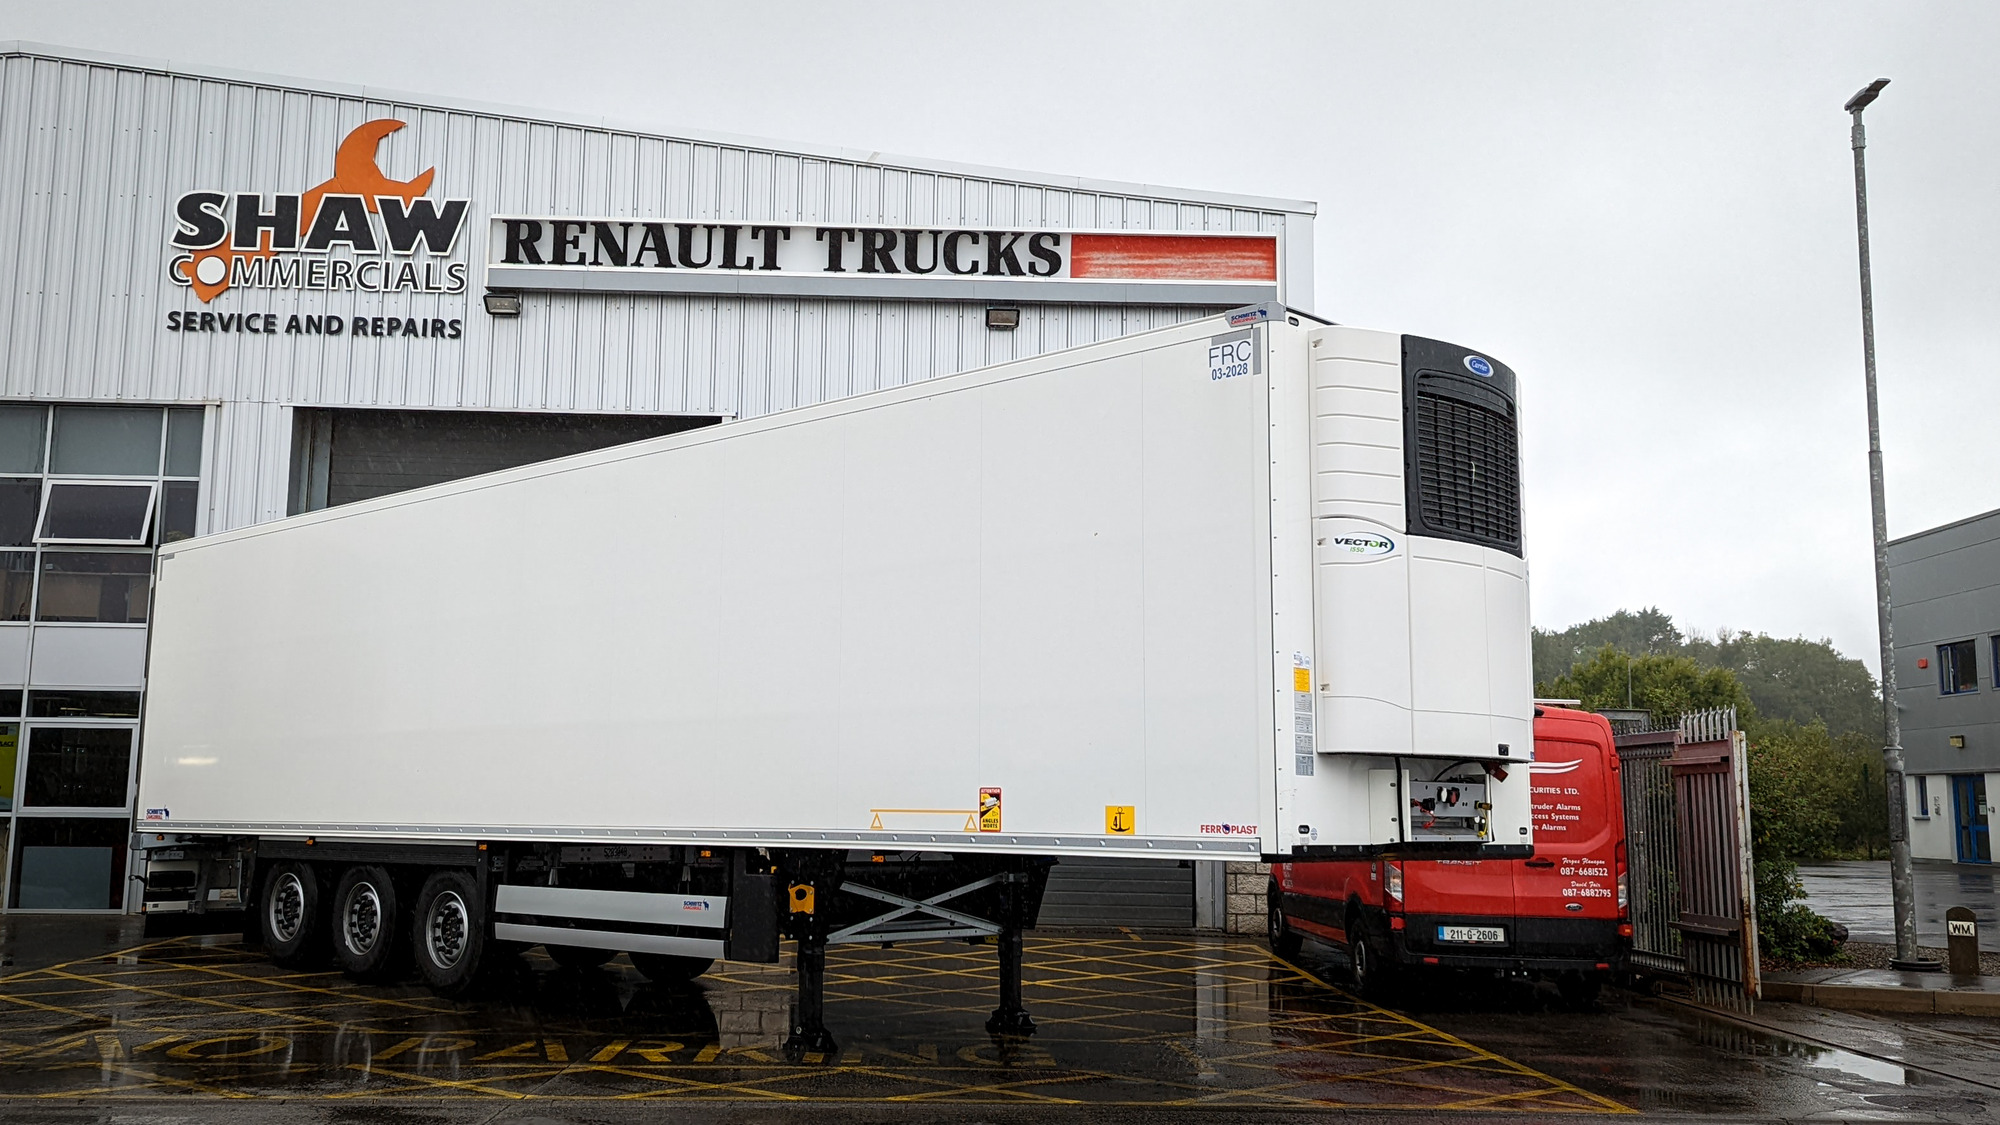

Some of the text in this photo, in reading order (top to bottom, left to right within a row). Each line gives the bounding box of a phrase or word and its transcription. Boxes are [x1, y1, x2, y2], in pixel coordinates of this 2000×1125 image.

[169, 190, 472, 255] SHAW
[500, 219, 1062, 277] RENAULT TRUCKS
[168, 253, 468, 293] COMMERCIALS
[1231, 311, 1257, 321] SCHMITZ
[167, 310, 462, 339] SERVICE AND REPAIRS
[1209, 341, 1251, 368] FRC
[1212, 363, 1248, 380] 03-2028
[1334, 538, 1389, 549] VECTOR
[1564, 787, 1580, 795] LTD.
[1556, 803, 1581, 811] Alarms
[1551, 812, 1580, 821] Systems
[1200, 824, 1258, 835] FERROPLAST
[1541, 823, 1567, 831] Alarms
[1560, 867, 1608, 876] 087-6681522
[1562, 888, 1611, 898] 087-6882795
[1450, 929, 1498, 940] 211-G-2606
[1952, 924, 1971, 934] WM
